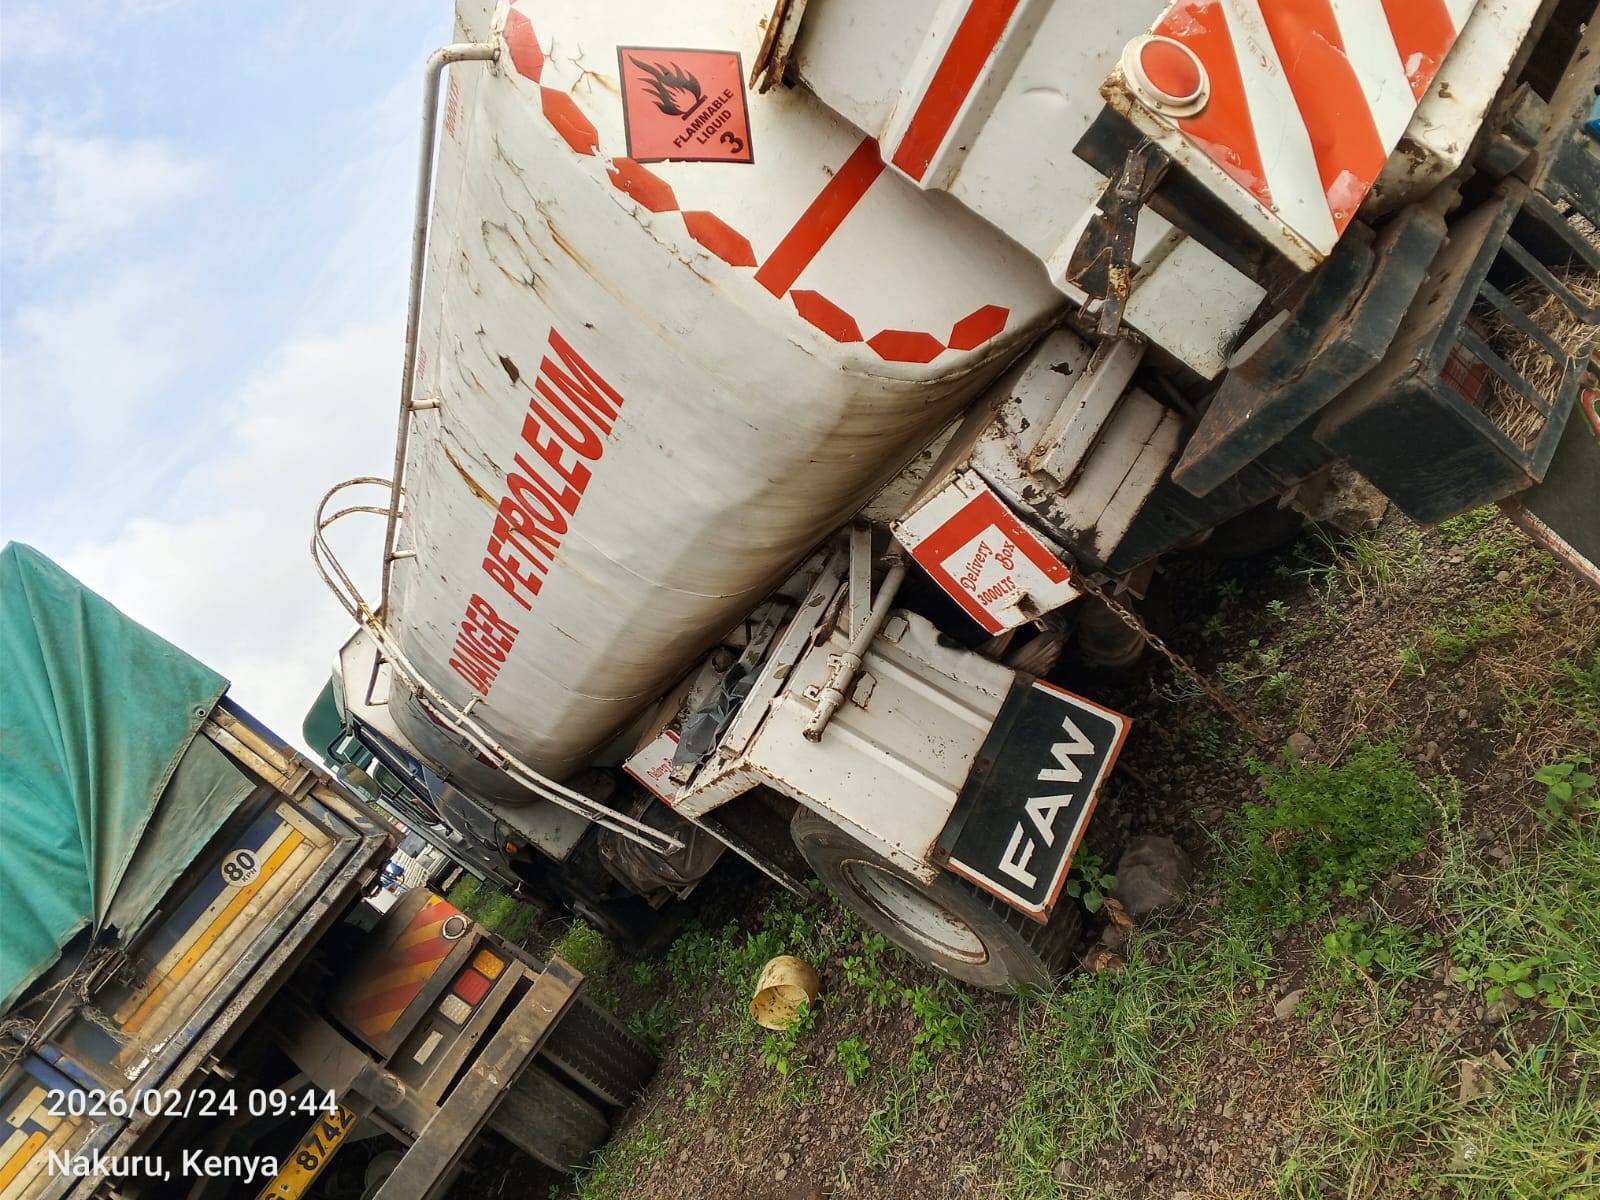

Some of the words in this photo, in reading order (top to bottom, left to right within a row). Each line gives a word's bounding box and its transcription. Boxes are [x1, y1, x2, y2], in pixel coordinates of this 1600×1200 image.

[673, 88, 734, 149] FLAMMABLE
[696, 109, 732, 145] LIQUID
[719, 131, 744, 154] 3
[482, 326, 625, 612] PETROLEUM
[960, 540, 993, 592] Delivery
[994, 540, 1015, 570] Box
[977, 575, 1016, 606] 3000LTS
[448, 593, 520, 696] DANGER
[998, 715, 1096, 889] FAW
[223, 851, 256, 882] 80
[241, 867, 257, 883] KPH
[296, 1104, 354, 1171] 8742
